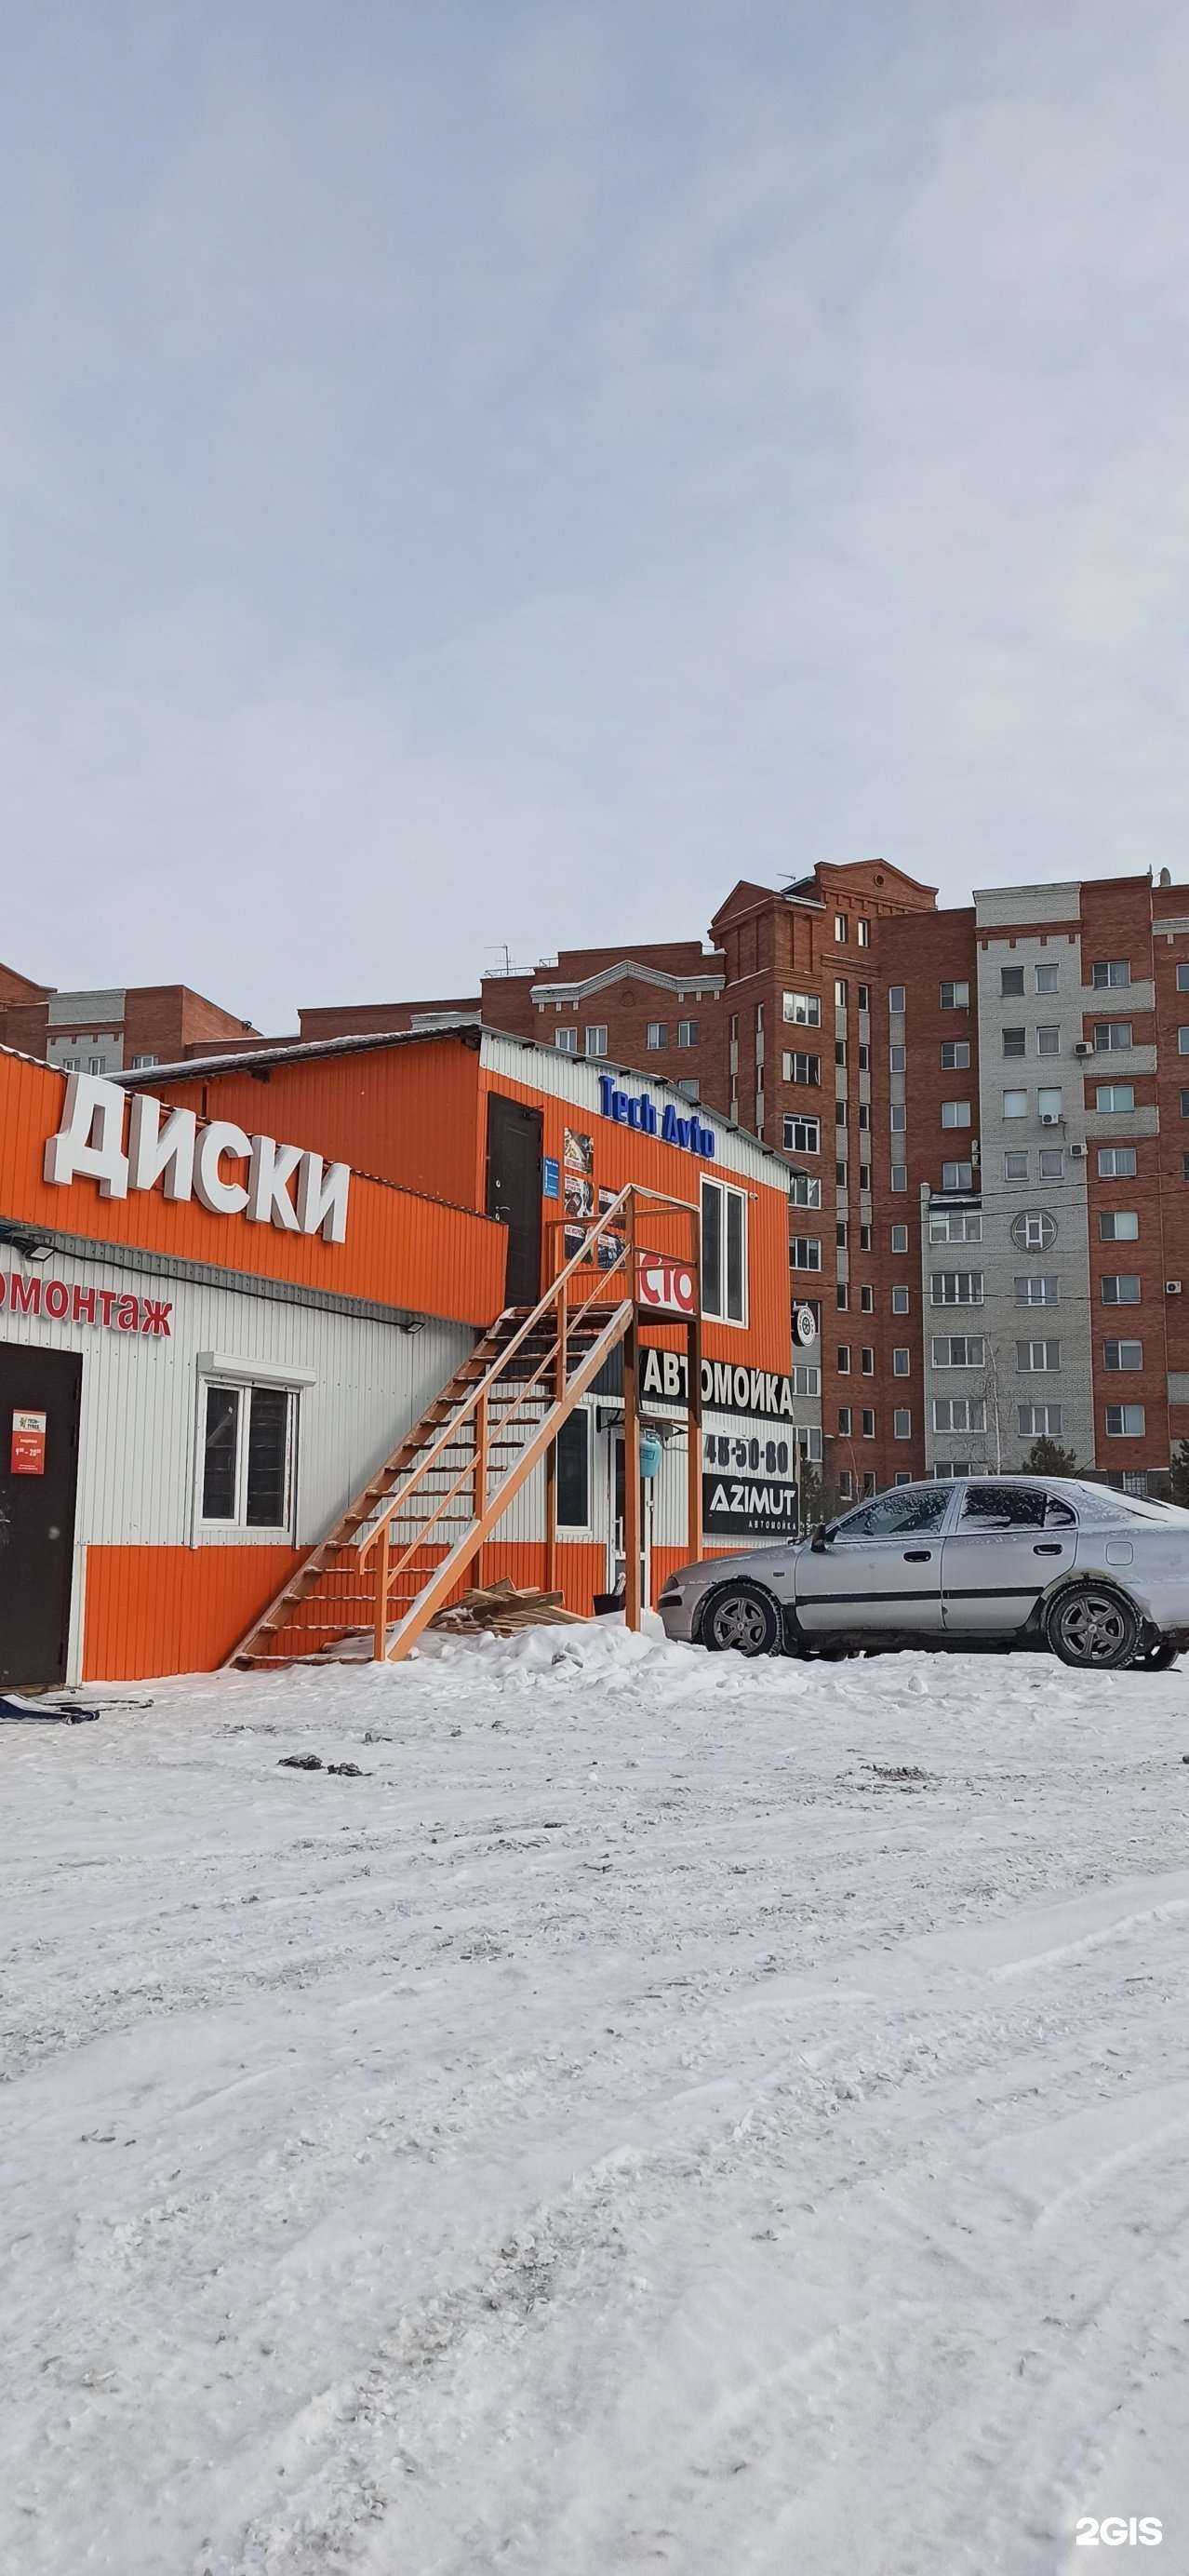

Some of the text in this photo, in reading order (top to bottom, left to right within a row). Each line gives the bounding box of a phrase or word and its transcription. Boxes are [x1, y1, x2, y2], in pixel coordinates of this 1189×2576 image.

[598, 1075, 657, 1134] Tech
[44, 1072, 350, 1245] ДИСКИ
[0, 1272, 173, 1336] монтаж
[643, 1348, 794, 1416] АВТОМОЙКА
[709, 1483, 796, 1516] AZIMUT
[748, 1520, 796, 1531] АВТОМОЙКА
